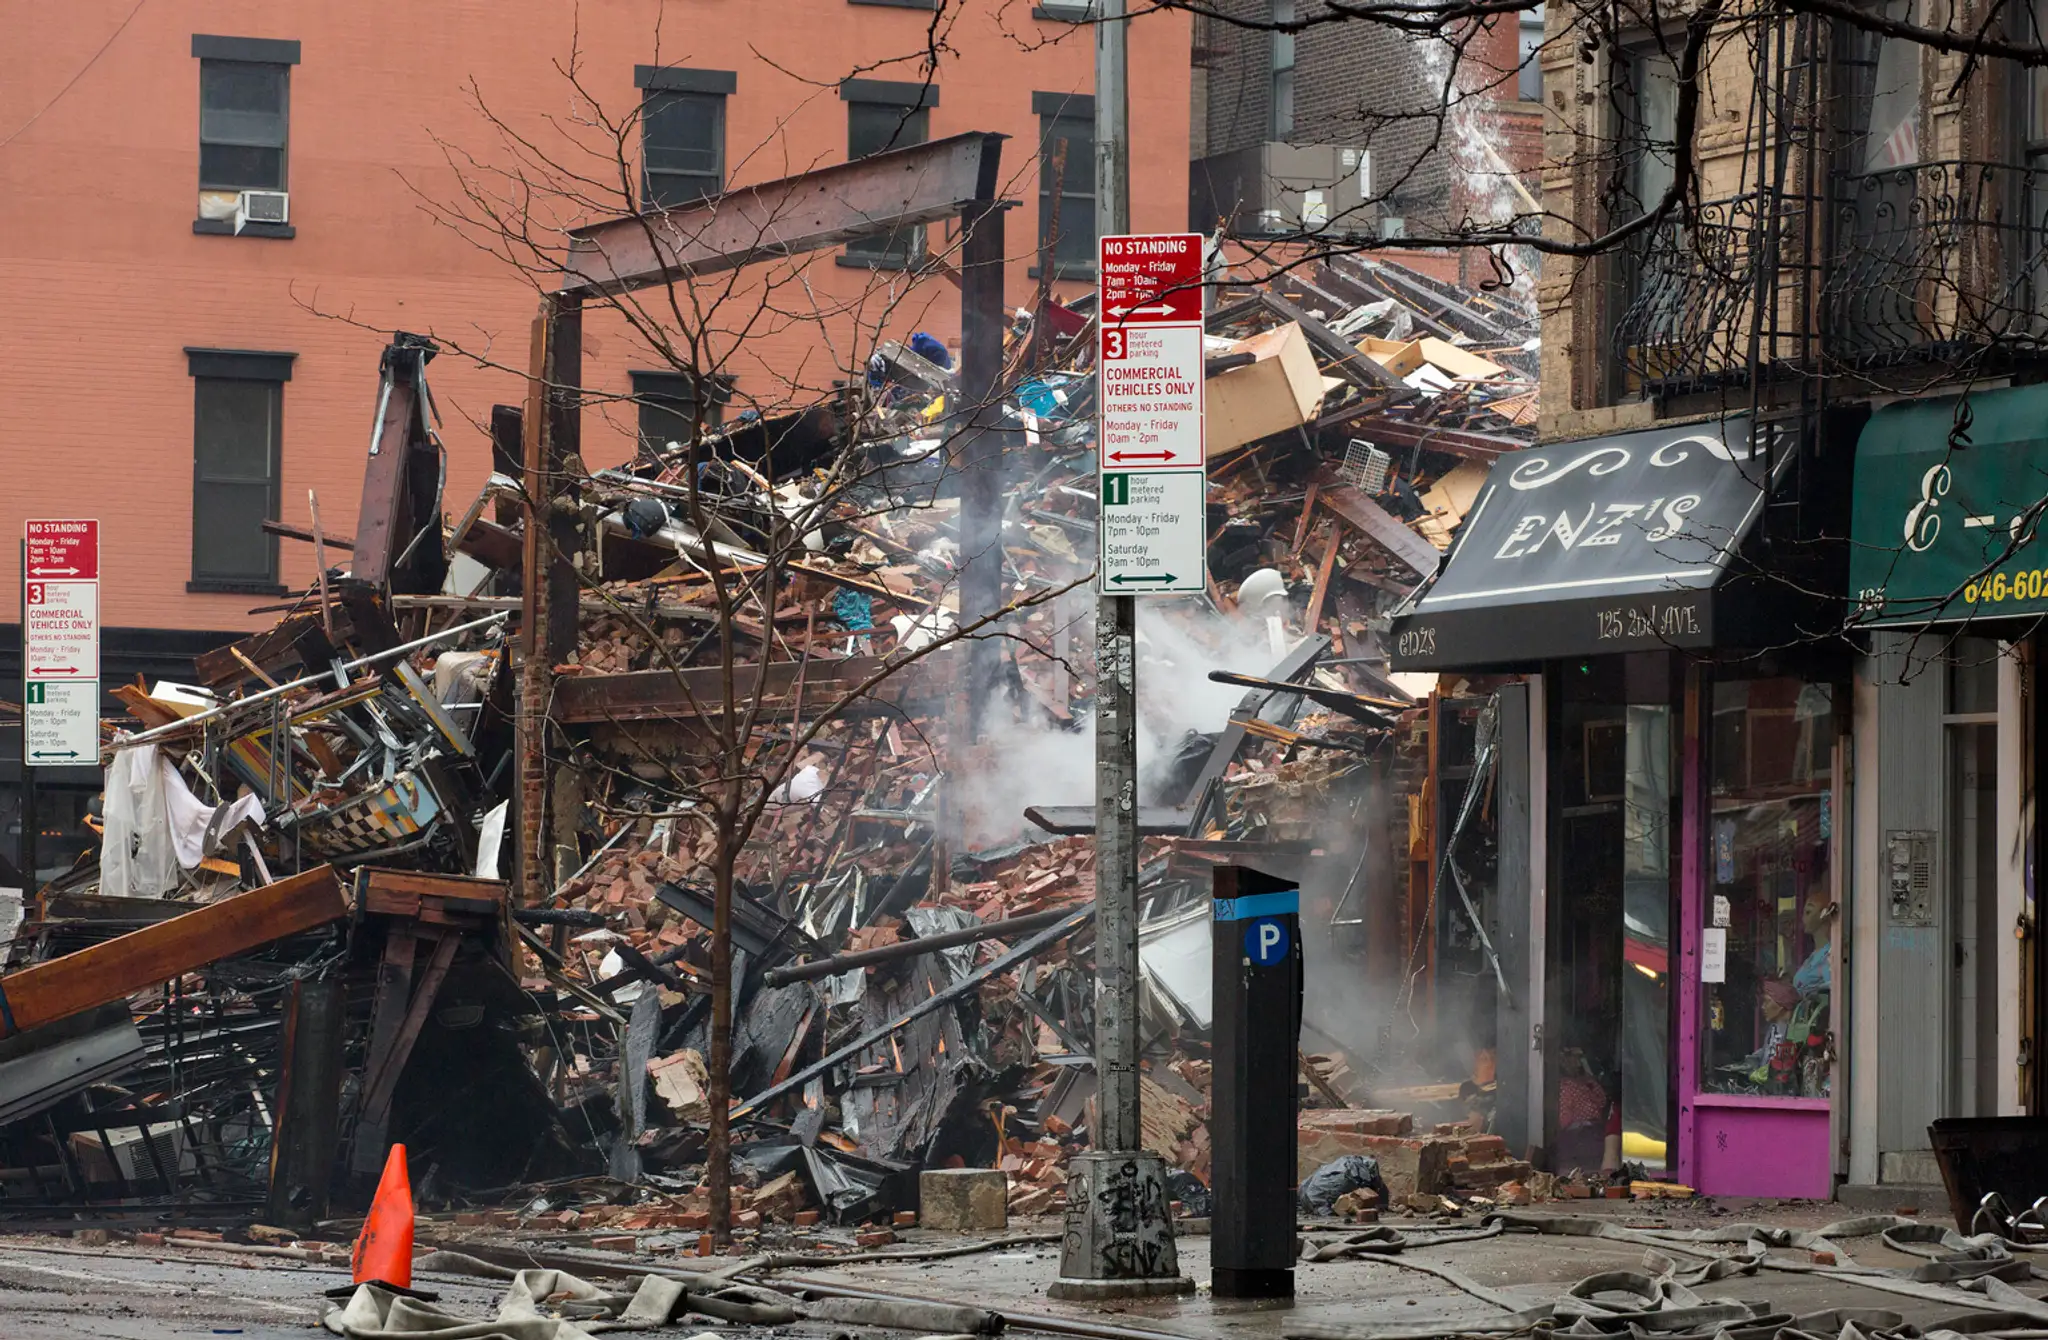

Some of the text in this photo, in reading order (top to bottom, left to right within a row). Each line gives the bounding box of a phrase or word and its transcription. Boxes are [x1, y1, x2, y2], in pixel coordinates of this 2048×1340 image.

[1105, 240, 1187, 255] NO STANDING
[1105, 262, 1140, 274] Monday
[1149, 260, 1177, 274] Friday
[1105, 275, 1125, 287] 7am
[1133, 274, 1158, 285] 10am
[1106, 288, 1126, 301] 2pm
[1129, 330, 1148, 339] hour
[1106, 331, 1123, 358] 3
[1129, 340, 1163, 348] metered
[1129, 349, 1159, 359] parking
[1106, 366, 1183, 380] COMMERCIAL
[1107, 382, 1195, 396] VEHICLES ONLY
[1106, 402, 1193, 413] OTHERS NO STANDING
[1106, 420, 1141, 432] Monday
[1150, 419, 1178, 431] Friday
[1107, 433, 1130, 443] 10am
[1139, 432, 1159, 444] 2pm
[1130, 476, 1148, 485] hour
[1110, 477, 1119, 503] 1
[1130, 485, 1164, 494] metered
[1130, 495, 1160, 505] parking
[1107, 513, 1142, 526] Monday
[1151, 512, 1180, 525] Friday
[30, 523, 88, 533] NO STANDING
[1108, 526, 1127, 538] 7pm
[1136, 525, 1160, 537] 10pm
[1493, 495, 1701, 559] ENZ'S
[30, 537, 54, 546] Monday
[60, 537, 80, 547] Friday
[1108, 544, 1148, 555] Saturday
[1108, 557, 1128, 567] 9am
[1136, 556, 1160, 568] 10pm
[30, 585, 42, 603] 3
[30, 609, 83, 619] COMMERCIAL
[30, 620, 93, 629] VEHICLES ONLY
[1597, 604, 1701, 639] 125 2nd AVE.
[30, 646, 54, 654] Monday
[61, 645, 80, 655] Friday
[32, 684, 39, 703] 1
[30, 709, 54, 717] Monday
[61, 708, 81, 718] Friday
[30, 730, 59, 738] Saturday
[1259, 923, 1280, 960] P
